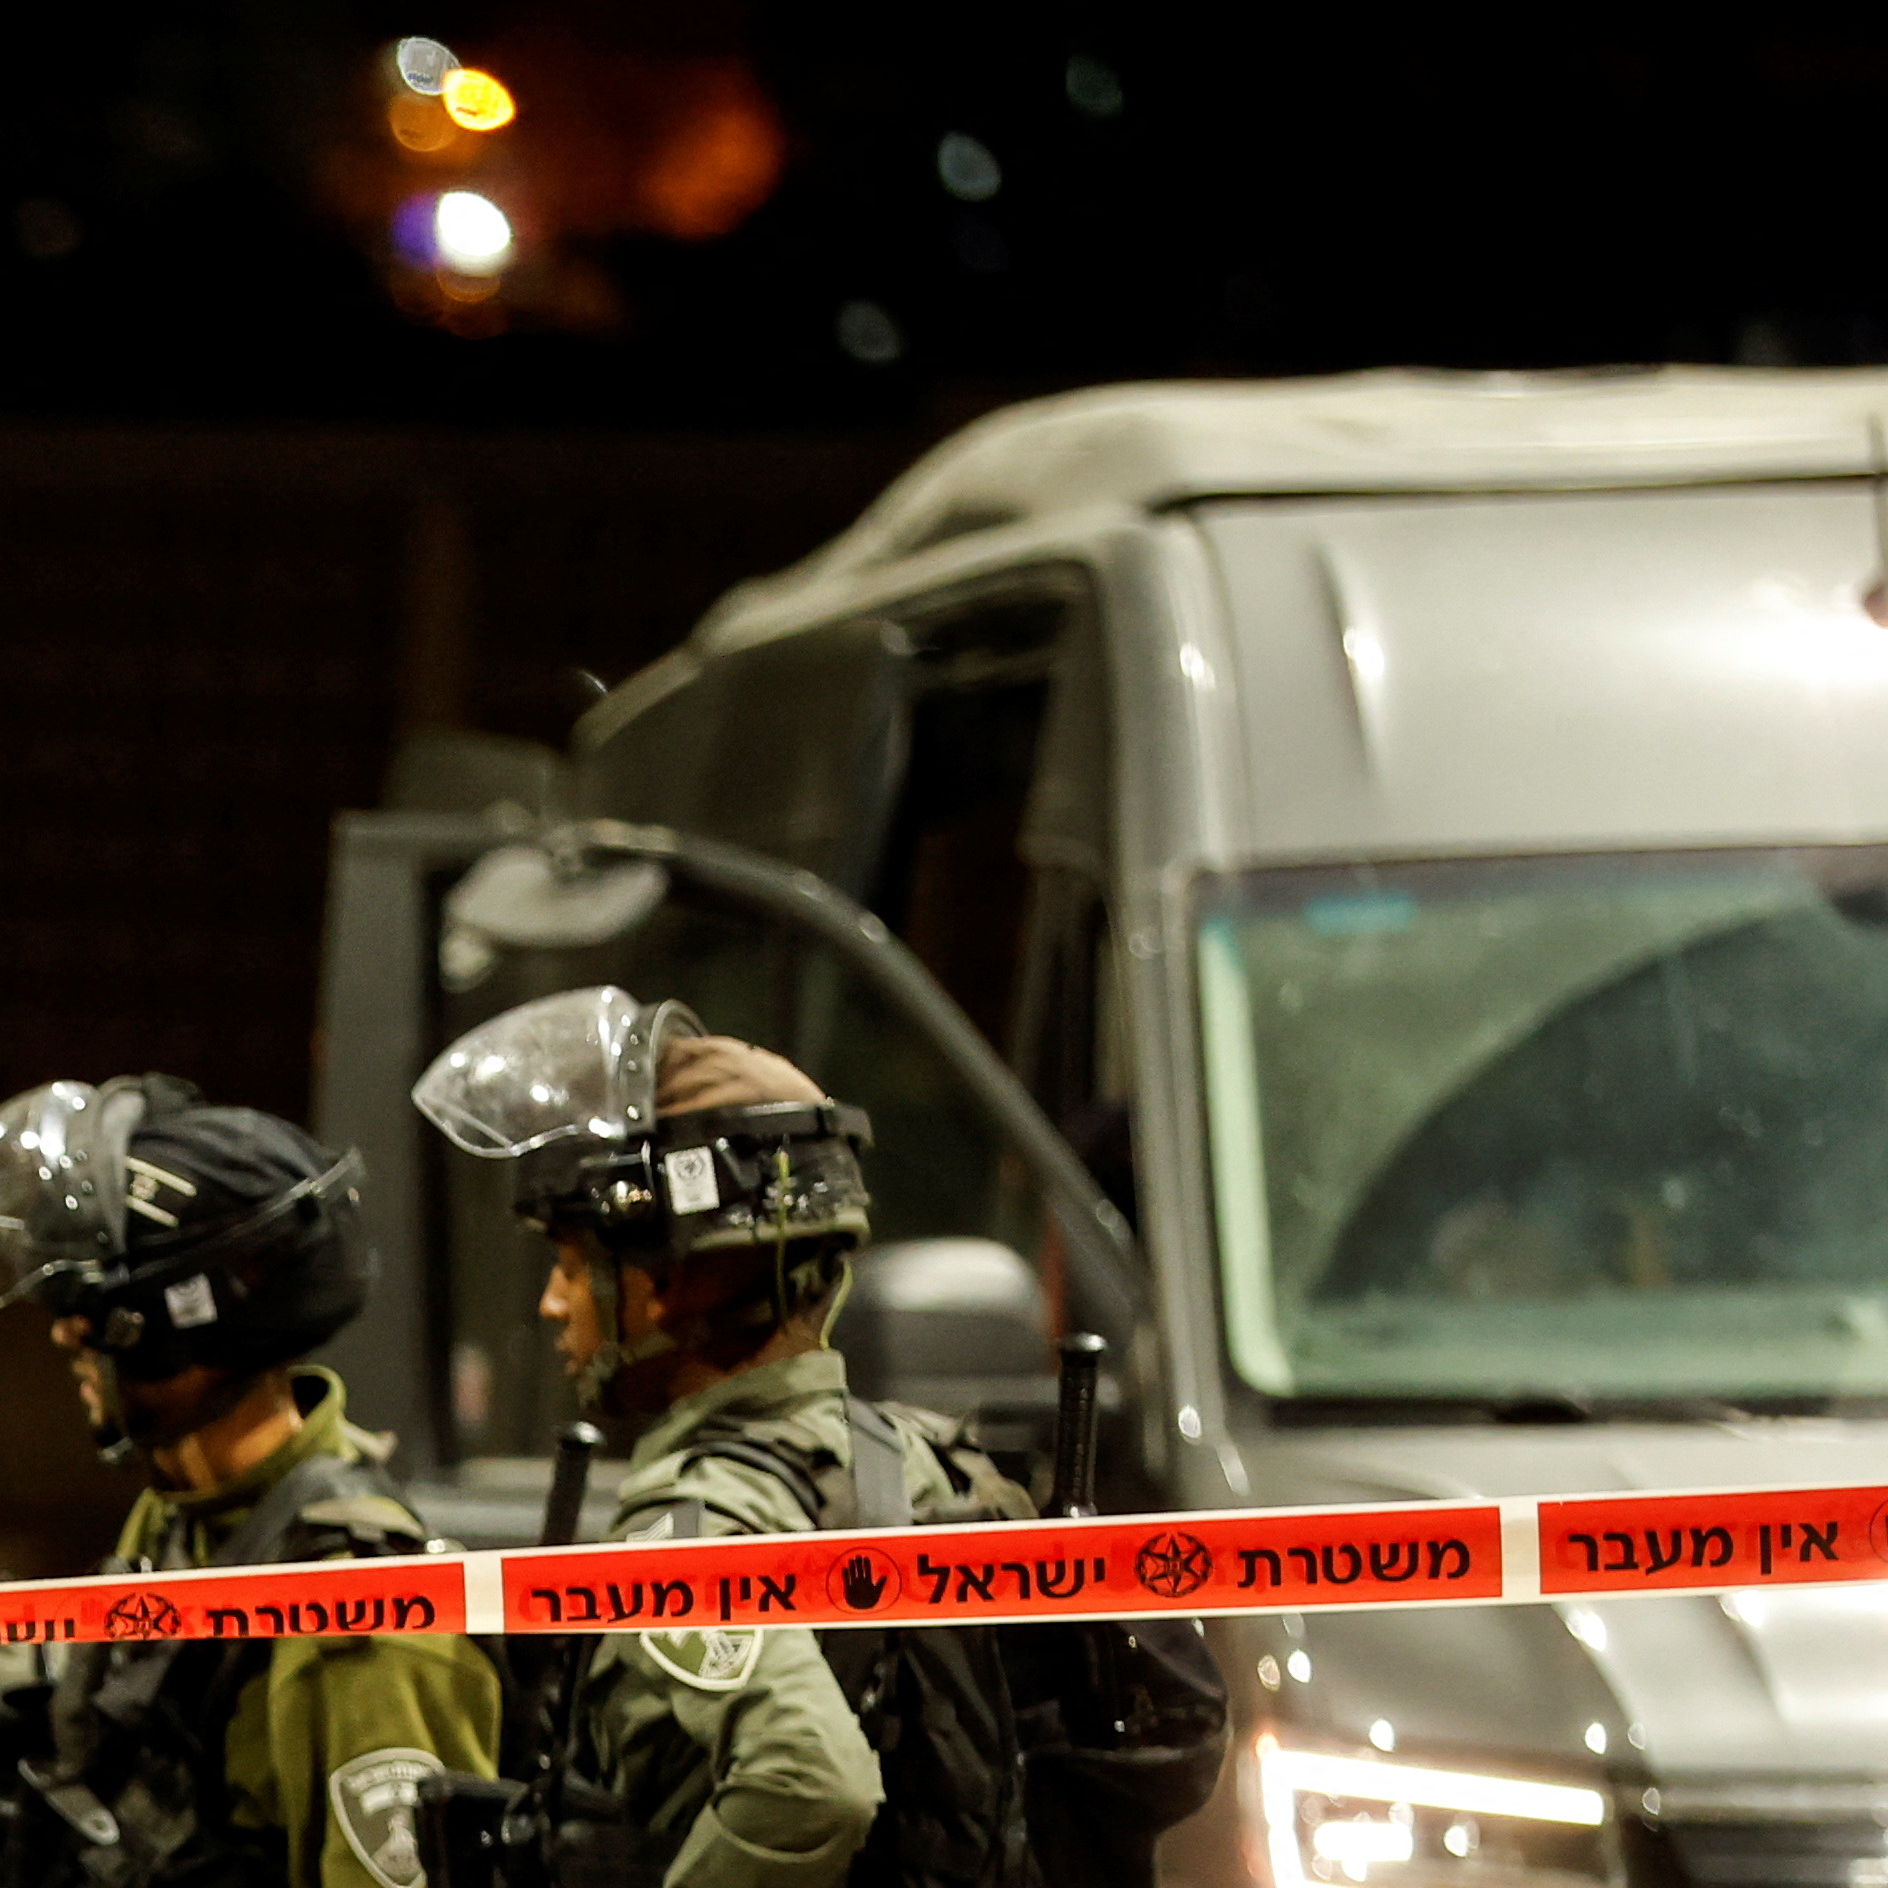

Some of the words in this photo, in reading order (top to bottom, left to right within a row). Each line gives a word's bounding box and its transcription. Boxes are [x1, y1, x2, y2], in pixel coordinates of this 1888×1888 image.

[1237, 1538, 1471, 1589] משטרת
[1567, 1526, 1735, 1575] מעבר
[1758, 1520, 1839, 1575] אין
[531, 1579, 695, 1622] מעבר
[719, 1573, 797, 1621] אין
[916, 1553, 1106, 1605] ישראל
[205, 1595, 436, 1637] משטרת
